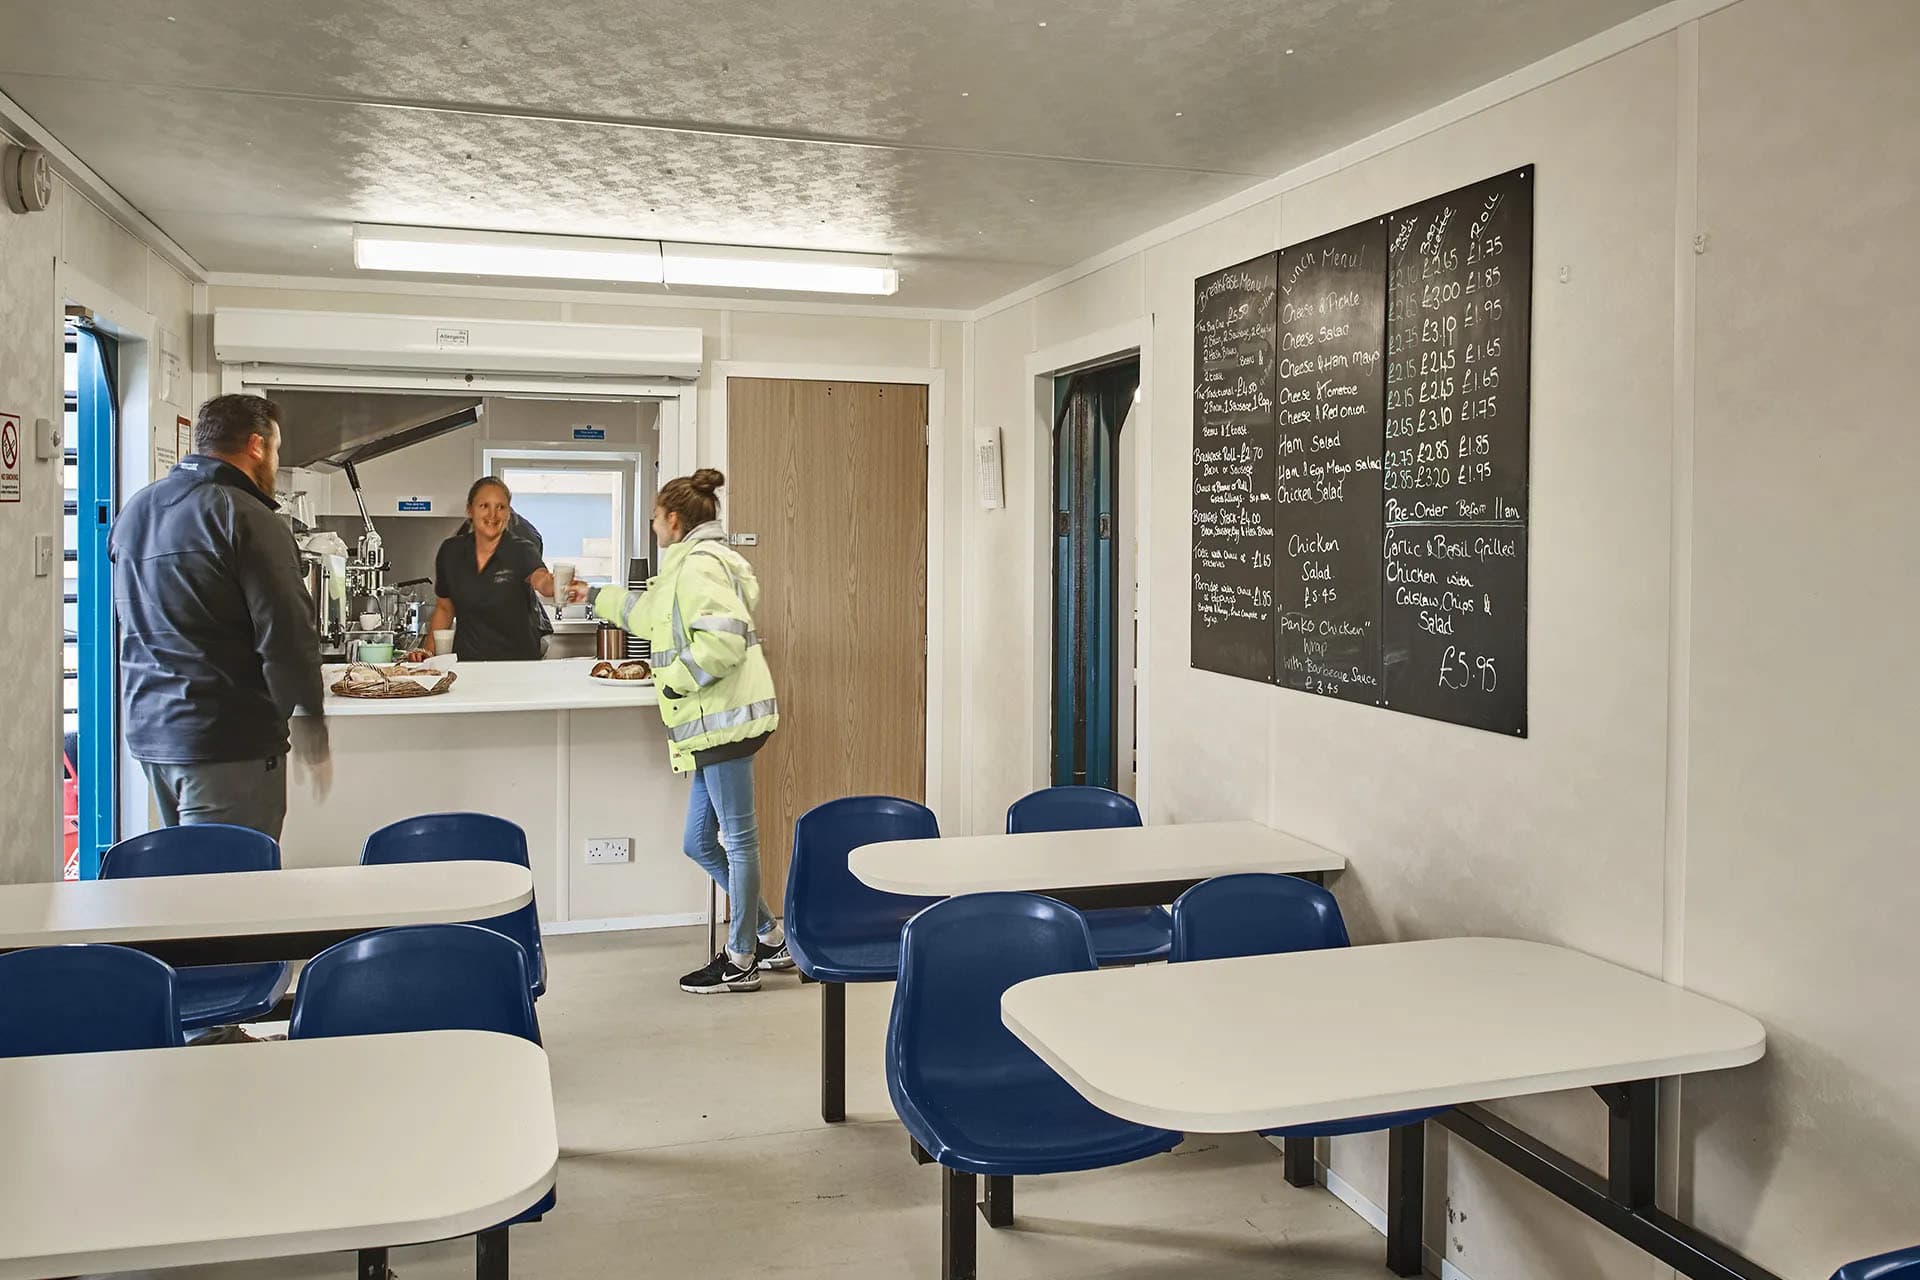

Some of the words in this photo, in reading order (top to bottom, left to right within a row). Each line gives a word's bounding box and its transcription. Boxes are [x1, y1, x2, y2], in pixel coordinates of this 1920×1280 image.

[1422, 248, 1459, 280] £2.65
[1467, 235, 1504, 266] £1.75
[1282, 252, 1316, 296] Lunch
[1422, 281, 1460, 310] £3.00
[1466, 266, 1501, 294] £1.85
[1197, 273, 1239, 312] Breakfast
[1282, 303, 1314, 325] Cheese
[1326, 290, 1360, 313] Pickle
[1464, 298, 1502, 328] £1.95
[1282, 331, 1315, 352] Cheese
[1318, 324, 1349, 343] Salad
[1280, 358, 1315, 379] Cheese
[1323, 354, 1348, 372] Ham
[1388, 358, 1417, 383] £2.15
[1465, 337, 1501, 363] £1.65
[1280, 387, 1312, 405] Cheese
[1387, 386, 1415, 410] £2.15
[1419, 376, 1454, 402] £2.45
[1462, 366, 1499, 395] £1.65
[1280, 409, 1312, 426] Cheese
[1322, 403, 1339, 420] Red
[1386, 417, 1414, 438] £2.65
[1417, 406, 1453, 433] £3.10
[1461, 395, 1497, 421] £1.75
[1278, 433, 1304, 457] Ham
[1310, 430, 1341, 453] Salad
[1384, 448, 1414, 470] £2.75
[1458, 434, 1490, 458] £1.85
[1278, 464, 1300, 486] Ham
[1309, 463, 1325, 484] Egg
[1326, 458, 1352, 483] Mayo
[1414, 465, 1450, 488] £3.20
[1457, 461, 1492, 485] £1.95
[1277, 485, 1313, 504] Chicken
[1313, 480, 1344, 504] Salad
[1455, 499, 1487, 519] Before
[1288, 532, 1340, 558] Chicken
[1383, 528, 1422, 562] Garlic
[1433, 534, 1472, 560] Basil
[1474, 537, 1516, 562] Grilled
[1386, 560, 1439, 584] Chicken
[1446, 571, 1474, 587] with
[1304, 586, 1337, 609] £5.45
[1442, 591, 1474, 615] Chips
[1417, 610, 1455, 635] Salad
[1350, 666, 1377, 686] Sauce
[1438, 645, 1498, 693] £5.95
